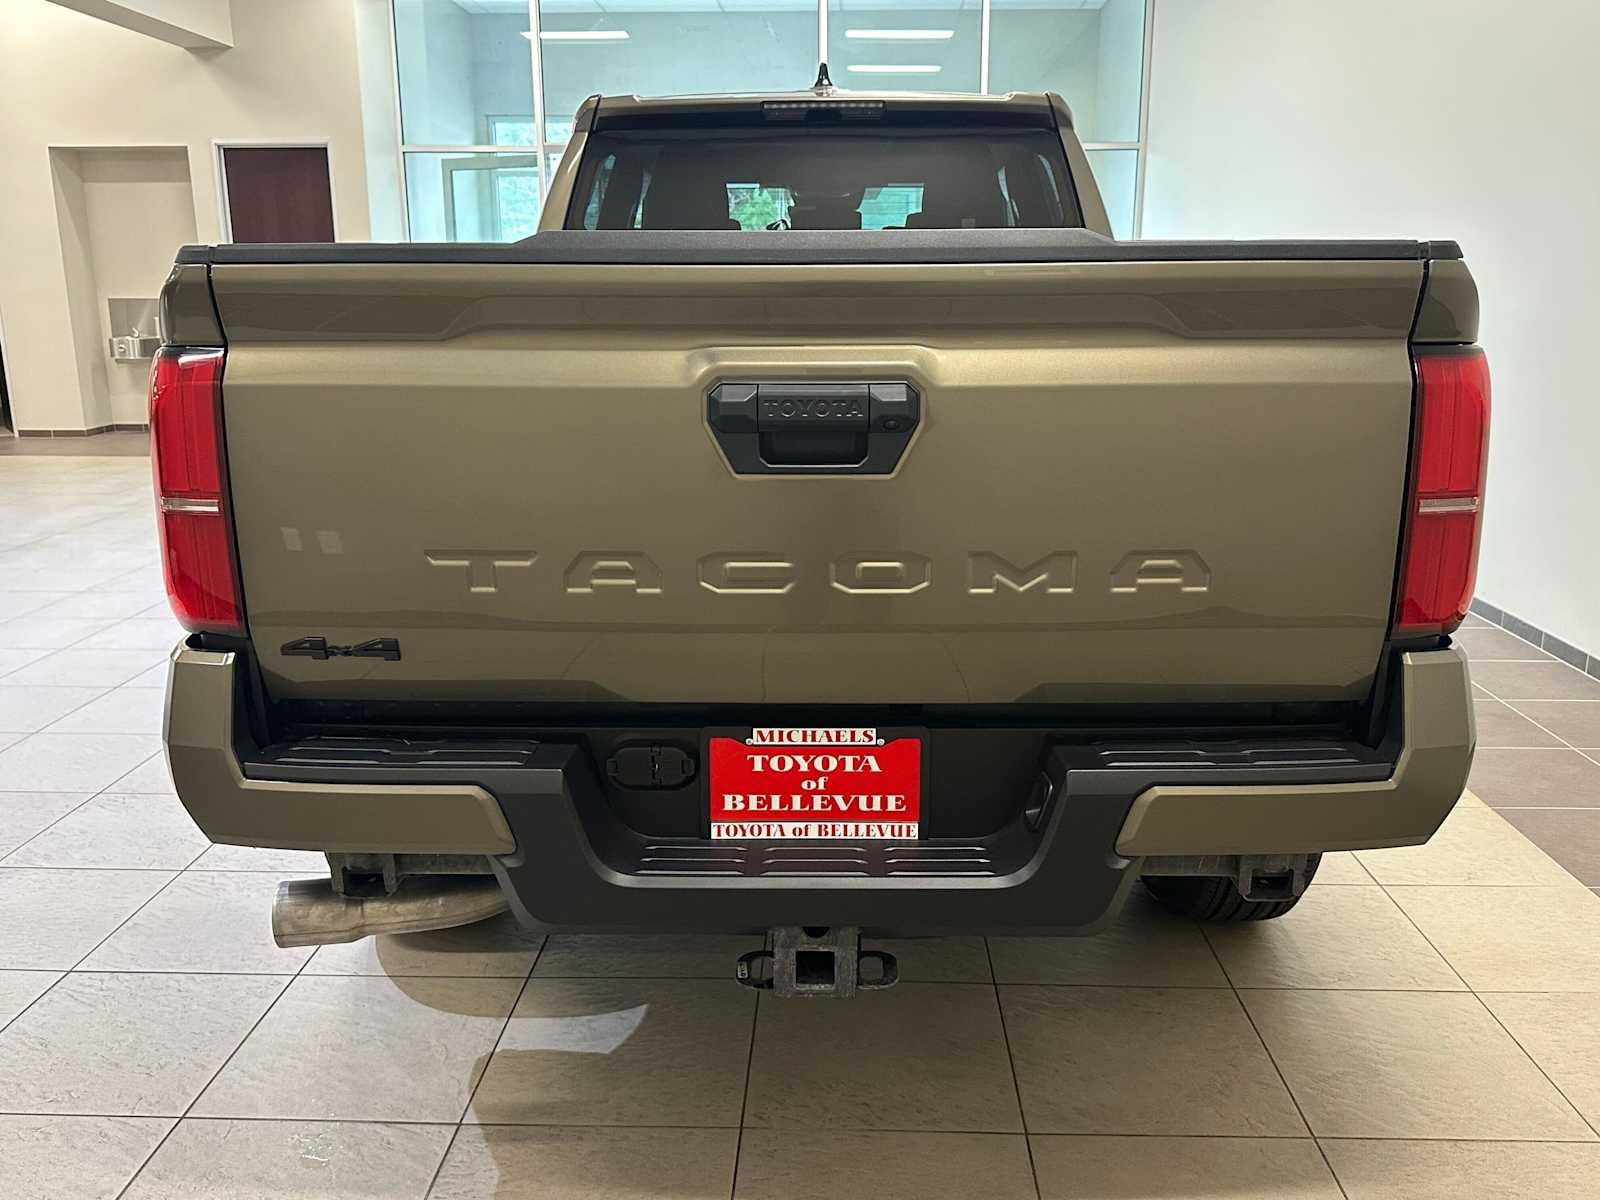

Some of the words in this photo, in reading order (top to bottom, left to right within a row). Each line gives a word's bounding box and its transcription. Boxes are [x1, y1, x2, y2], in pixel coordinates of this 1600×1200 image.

[763, 400, 864, 417] TOYOTA
[424, 550, 1212, 594] TACOMA
[756, 729, 874, 743] MICHAELS
[747, 755, 882, 772] TOYOTA
[801, 776, 829, 790] of
[722, 794, 907, 811] BELLEVUE
[713, 824, 785, 838] TOYOTA
[792, 824, 813, 837] of
[817, 824, 917, 838] BELLEVUE
